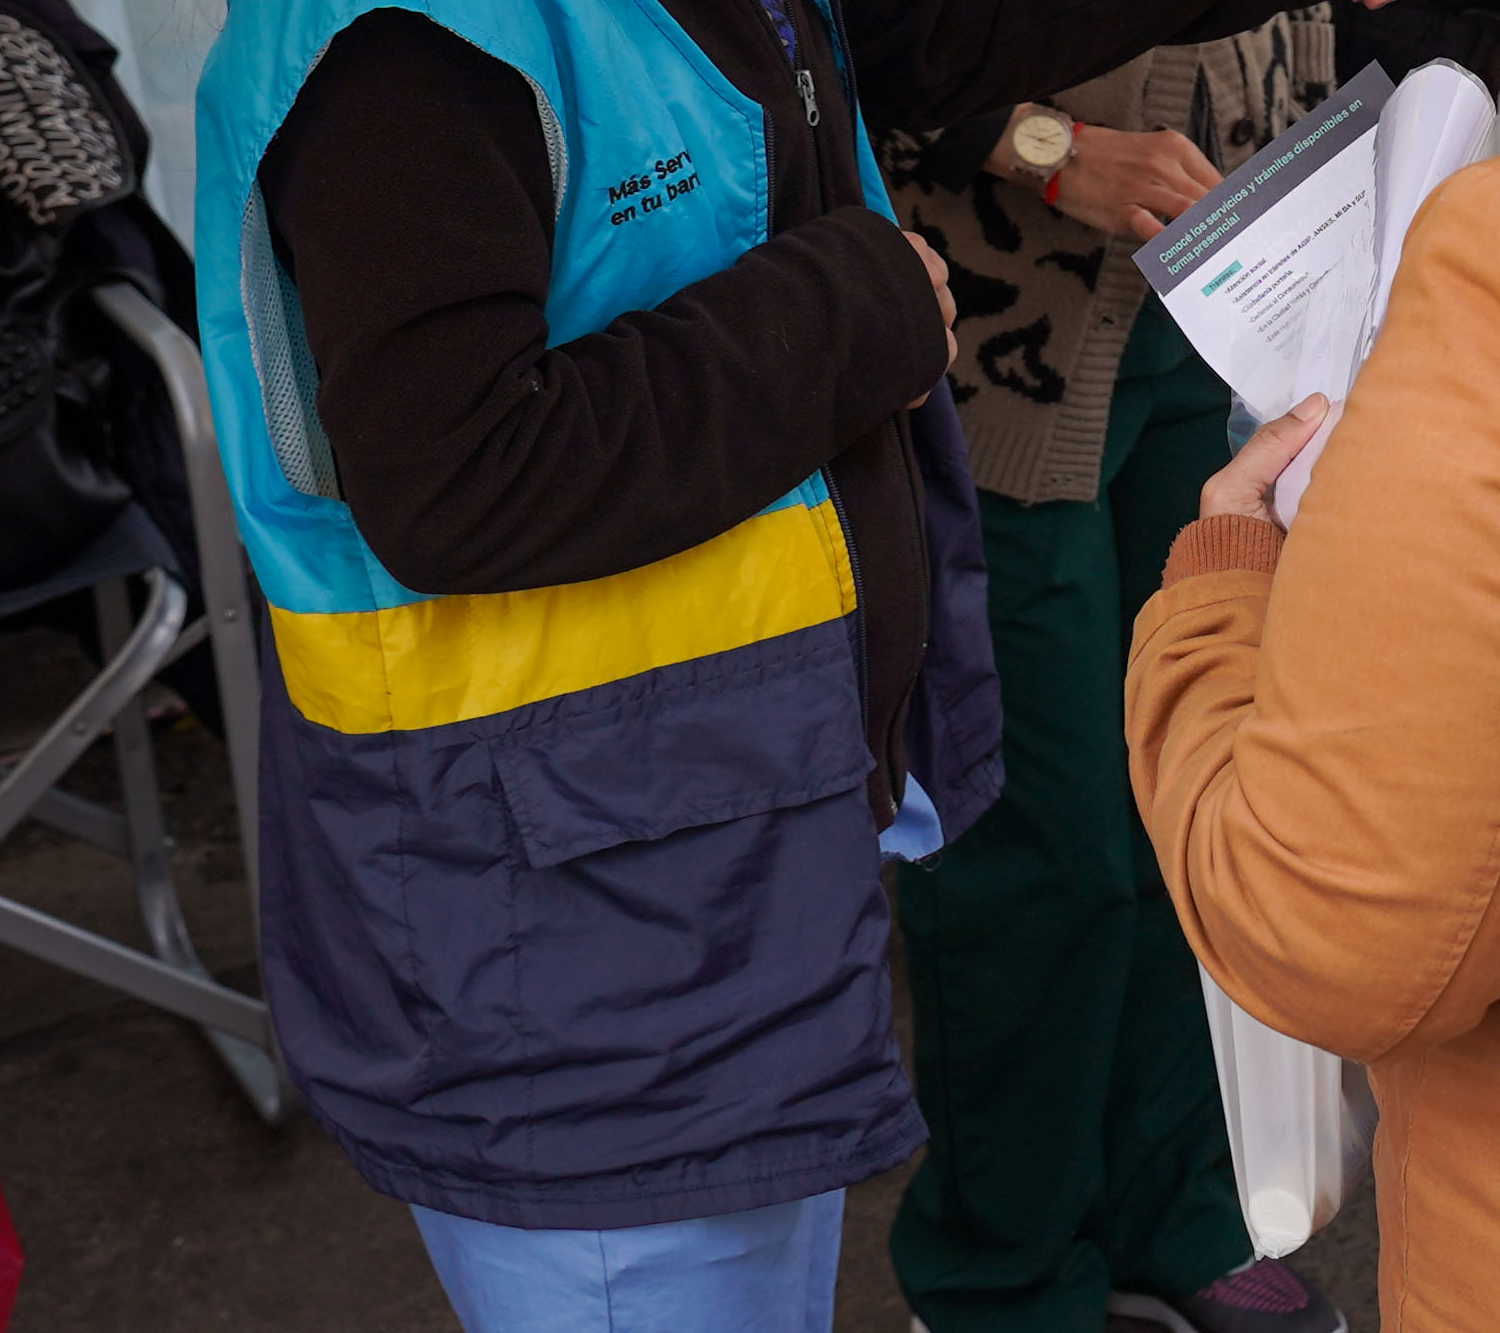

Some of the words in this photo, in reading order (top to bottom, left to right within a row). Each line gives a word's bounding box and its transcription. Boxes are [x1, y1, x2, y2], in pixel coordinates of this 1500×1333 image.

[608, 174, 651, 205] Más
[1159, 231, 1194, 264] Conocé
[1191, 222, 1208, 238] los
[1205, 189, 1249, 227] servicios
[1248, 183, 1256, 193] y
[1254, 151, 1295, 185] trámites
[1293, 110, 1349, 155] disponibles
[1349, 98, 1363, 112] en
[611, 206, 637, 226] en
[641, 194, 662, 213] tu
[1167, 253, 1194, 276] forma
[1192, 213, 1241, 259] presencial
